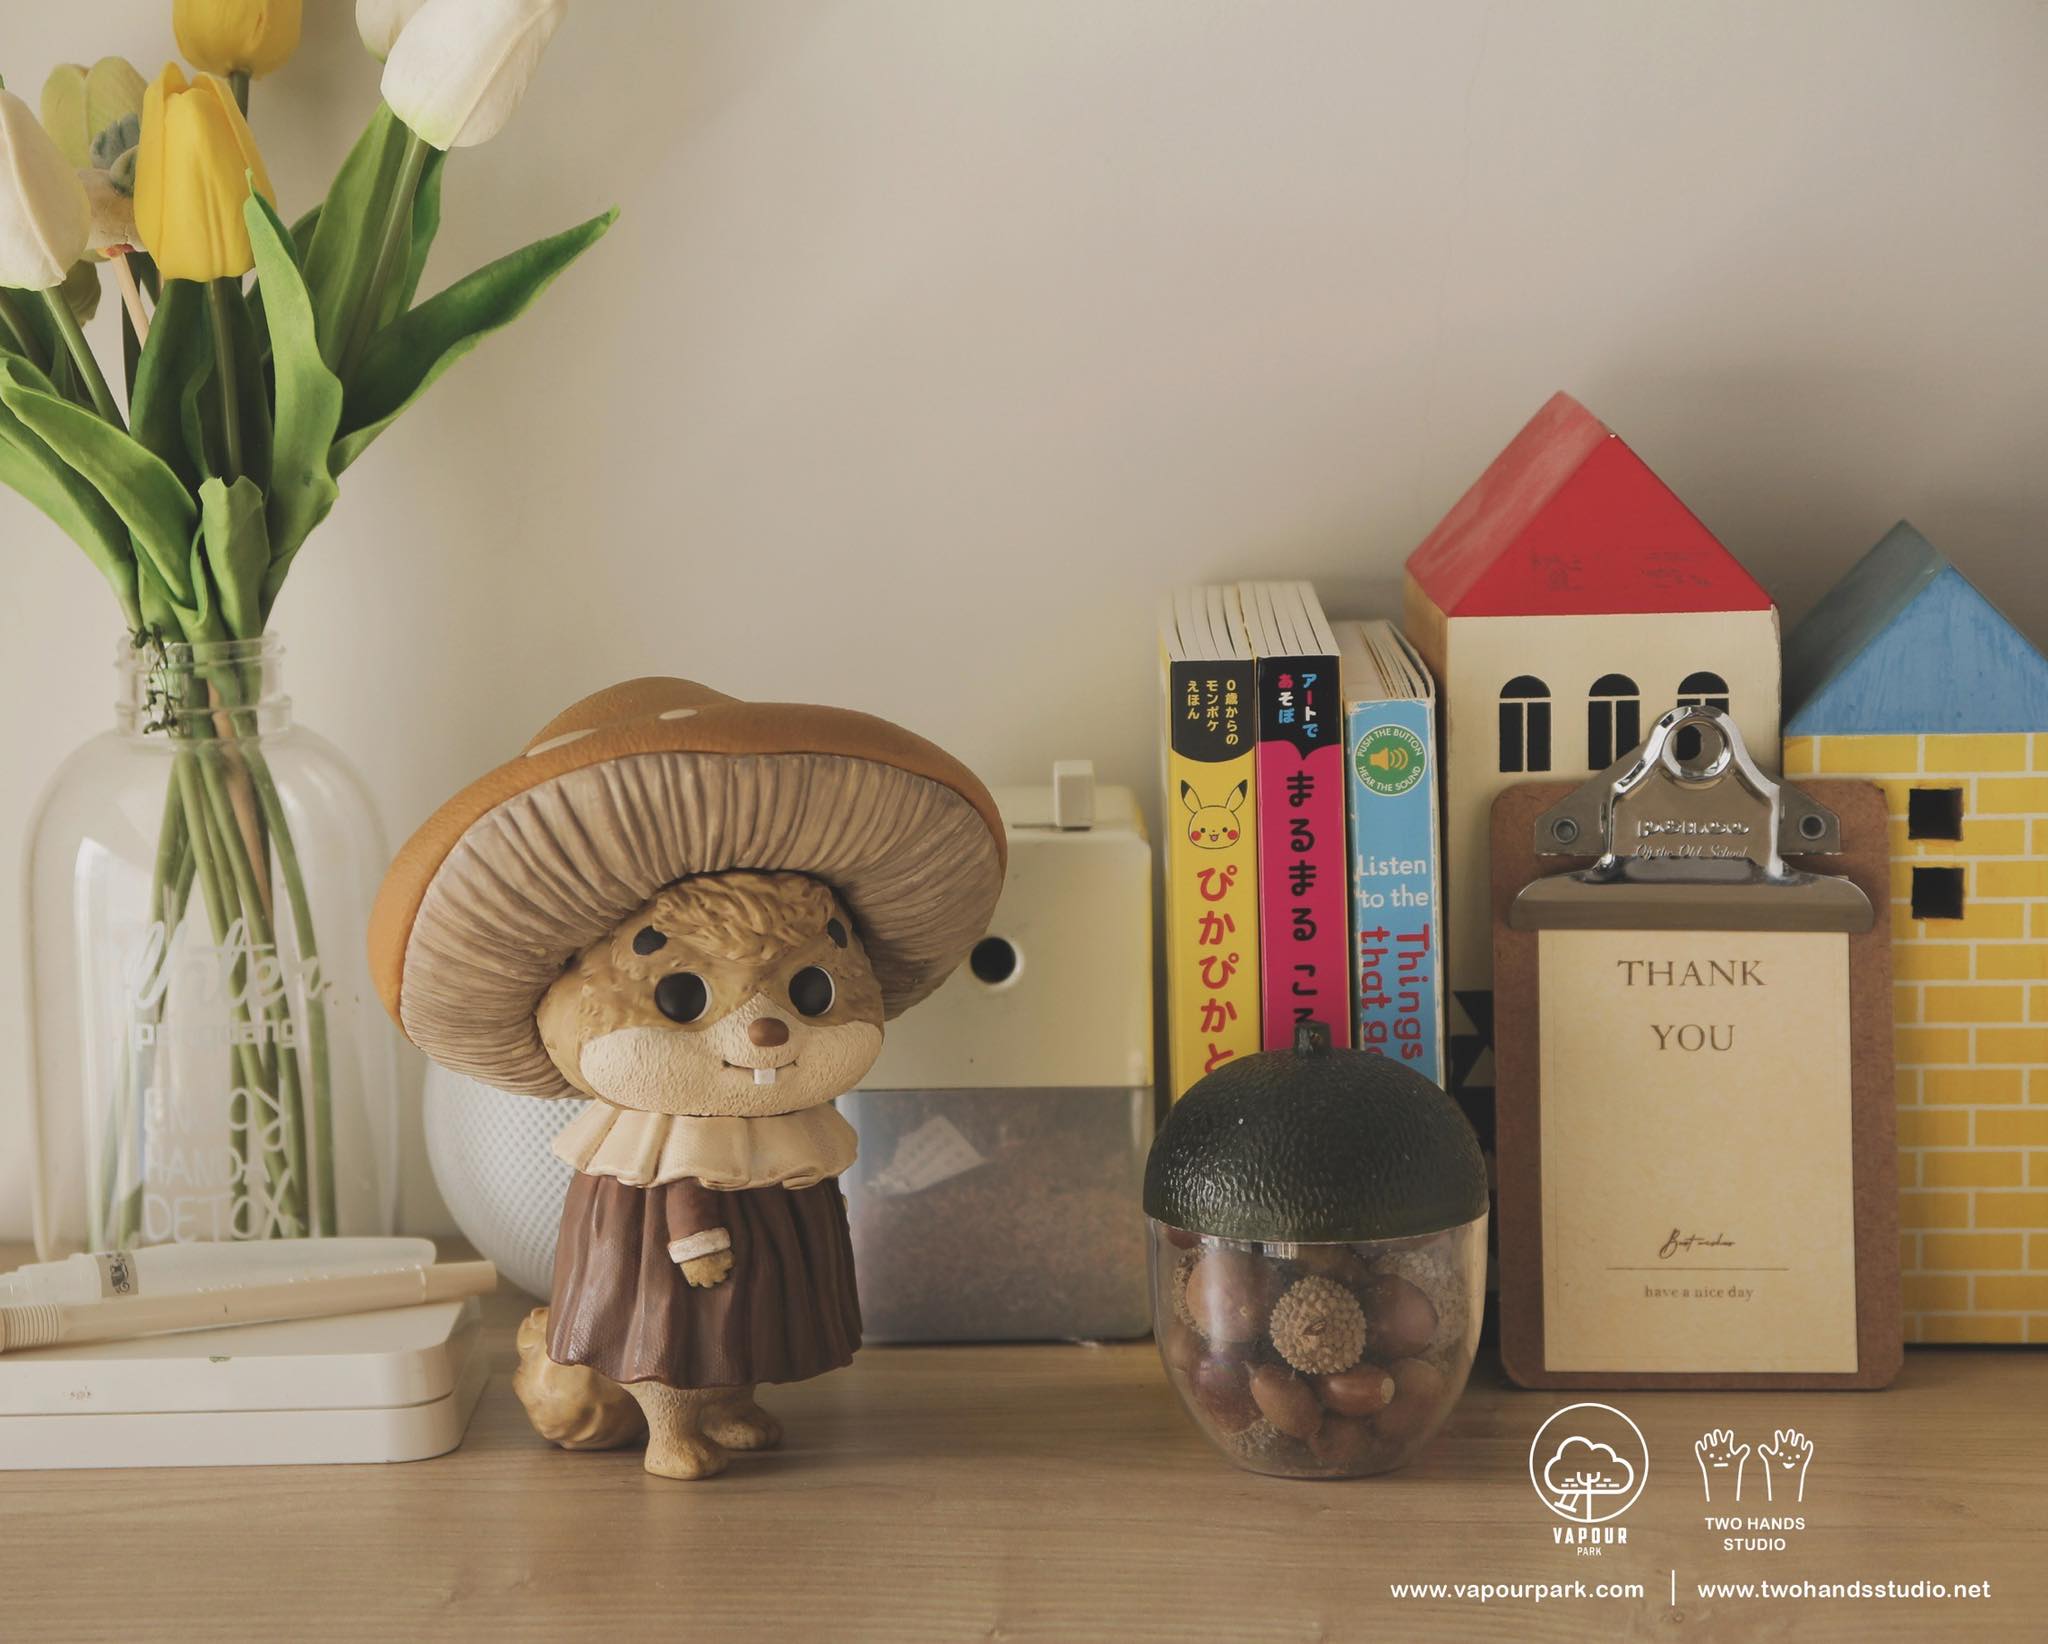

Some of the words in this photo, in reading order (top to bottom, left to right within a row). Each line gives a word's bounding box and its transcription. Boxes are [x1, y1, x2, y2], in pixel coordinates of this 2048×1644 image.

[1187, 680, 1200, 720] えほん
[1206, 680, 1219, 732] モンポケ
[1225, 679, 1238, 746] 0歳からの
[1278, 673, 1295, 724] あそぼ
[1301, 673, 1319, 738] アートで
[1358, 736, 1374, 757] PUSH
[1373, 728, 1391, 739] THE
[1393, 728, 1423, 756] BUTTON
[1359, 765, 1376, 787] HEAR
[1376, 782, 1393, 792] THE
[1395, 766, 1421, 791] SOUND
[1360, 854, 1427, 876] Listen
[1360, 889, 1384, 908] to
[1390, 883, 1429, 907] the
[1360, 926, 1392, 1009] that
[1617, 960, 1767, 986] THANK
[1393, 923, 1430, 1060] Things
[1651, 1024, 1735, 1051] YOU
[143, 1168, 304, 1243] DETOX
[1645, 1285, 1679, 1298] have
[1682, 1288, 1691, 1298] a
[1695, 1286, 1725, 1298] nice
[1728, 1284, 1754, 1302] day
